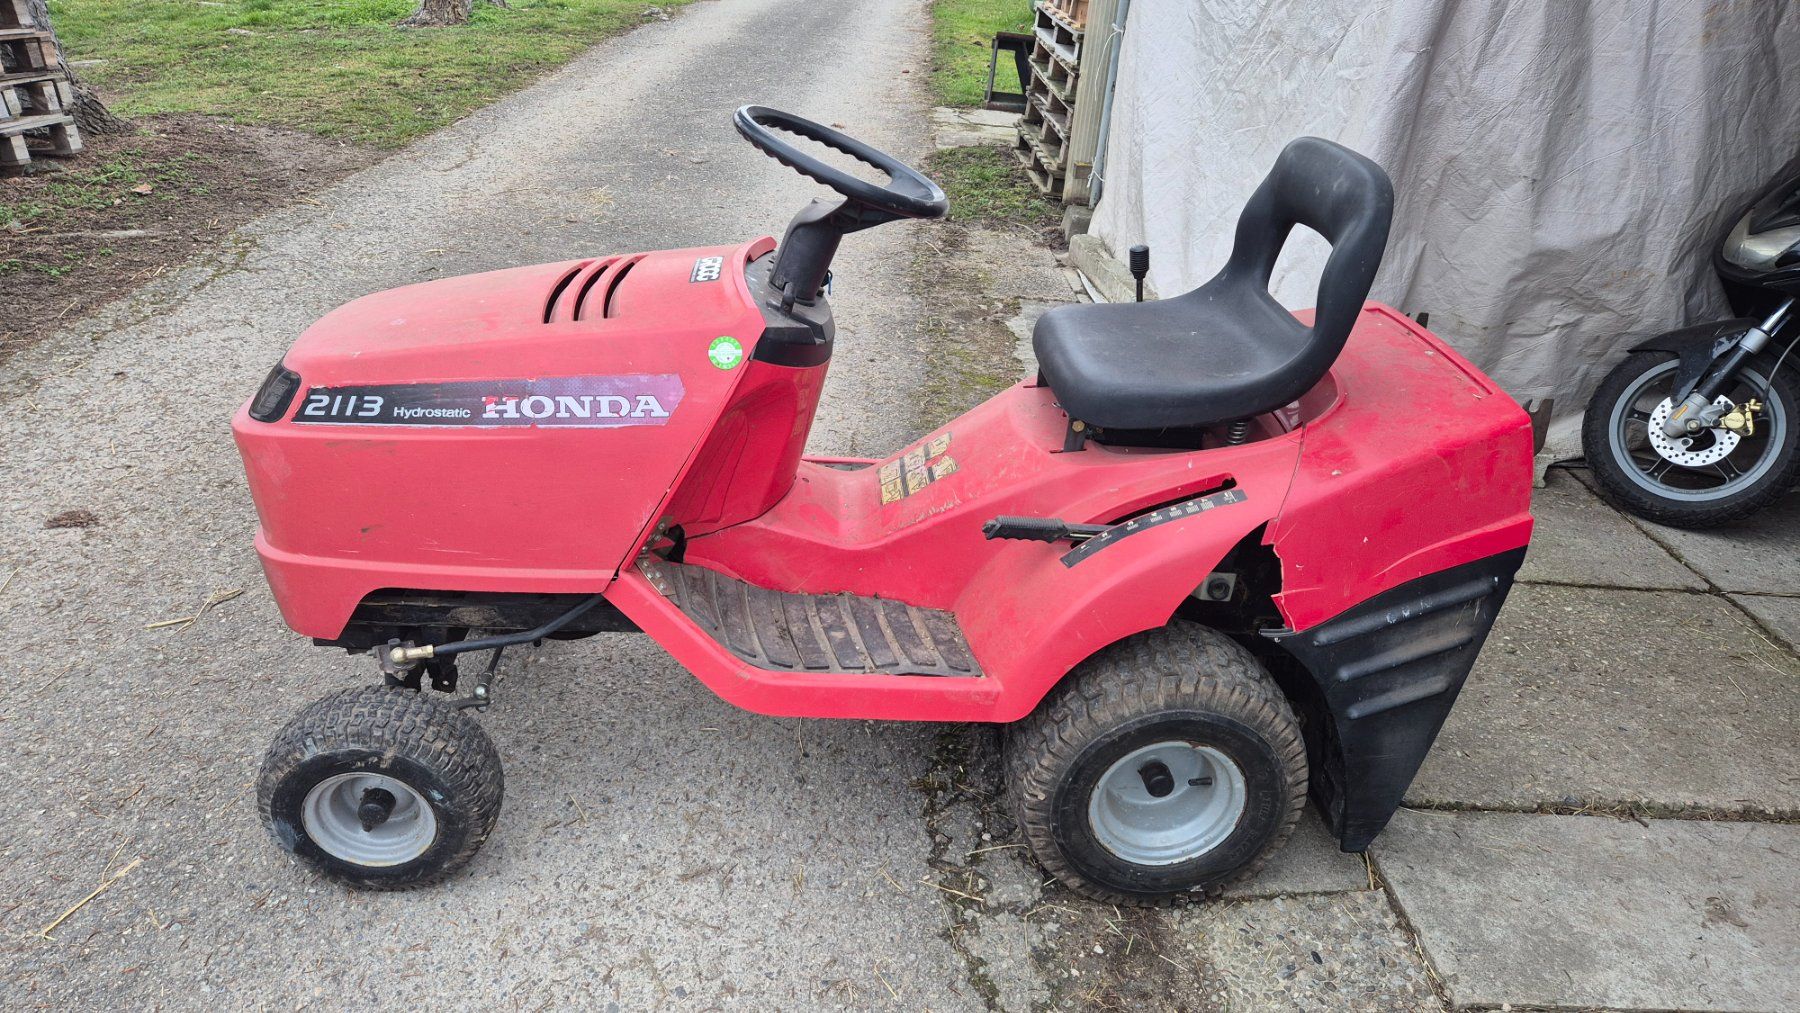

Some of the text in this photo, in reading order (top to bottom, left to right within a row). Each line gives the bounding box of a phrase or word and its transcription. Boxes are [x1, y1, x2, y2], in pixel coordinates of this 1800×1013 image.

[304, 395, 670, 420] 2113 Hydrostatic HONDA
